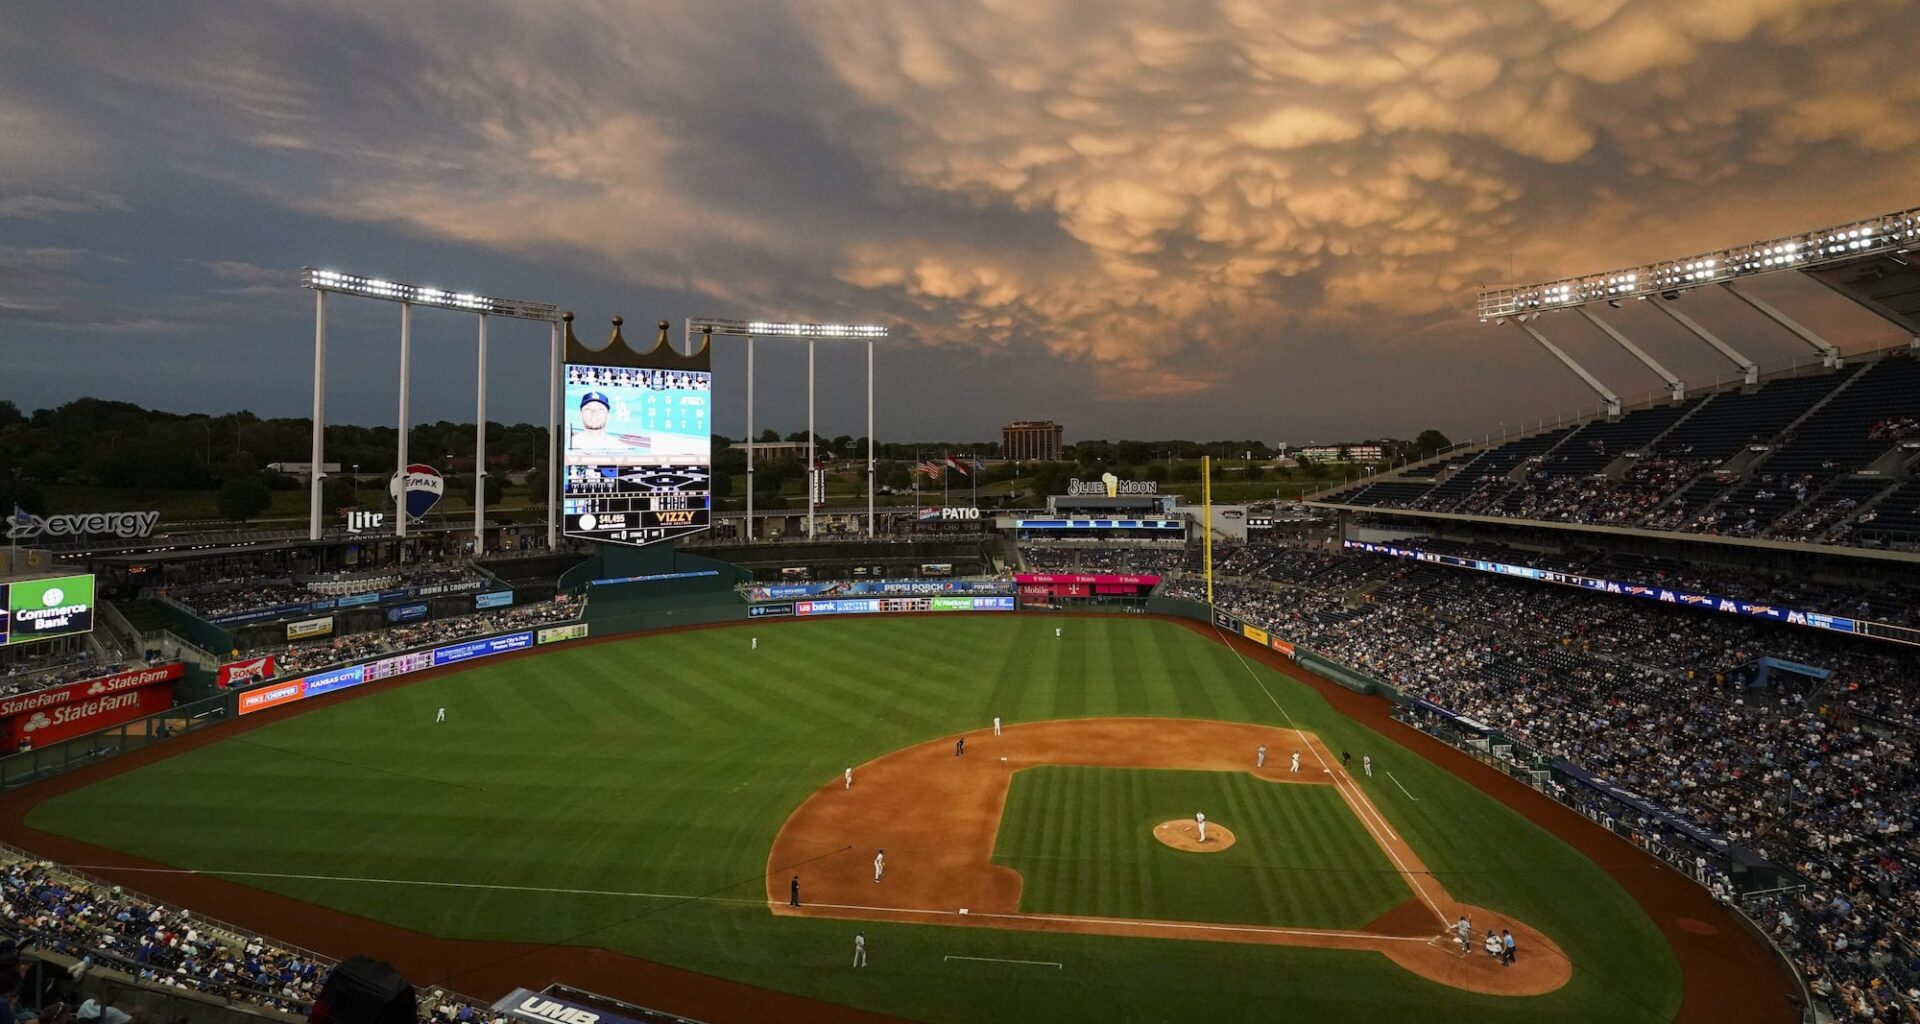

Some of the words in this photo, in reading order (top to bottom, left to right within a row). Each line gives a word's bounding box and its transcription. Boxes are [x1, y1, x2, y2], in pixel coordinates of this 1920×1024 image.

[656, 512, 695, 522] VIZZY
[942, 507, 980, 520] PATIO
[47, 511, 160, 538] evergy
[346, 511, 384, 534] Lite
[621, 530, 627, 540] 0
[419, 586, 443, 596] BROWN
[443, 585, 449, 593] &
[885, 583, 910, 592] PEPSI
[912, 583, 944, 593] PORCH
[1024, 586, 1048, 594] Mobile
[16, 604, 87, 621] Commerce
[800, 604, 811, 612] us
[812, 602, 836, 611] bank
[35, 616, 69, 630] Bank
[508, 640, 526, 649] Therapy
[232, 667, 261, 680] SONIC
[107, 676, 139, 691] State
[138, 670, 168, 684] Farm
[310, 677, 338, 689] KANSAS
[340, 672, 355, 681] CITY
[1, 699, 37, 716] State
[37, 691, 70, 706] Farm
[53, 702, 99, 725] State
[98, 691, 138, 712] Farm
[520, 996, 600, 1024] UMB
